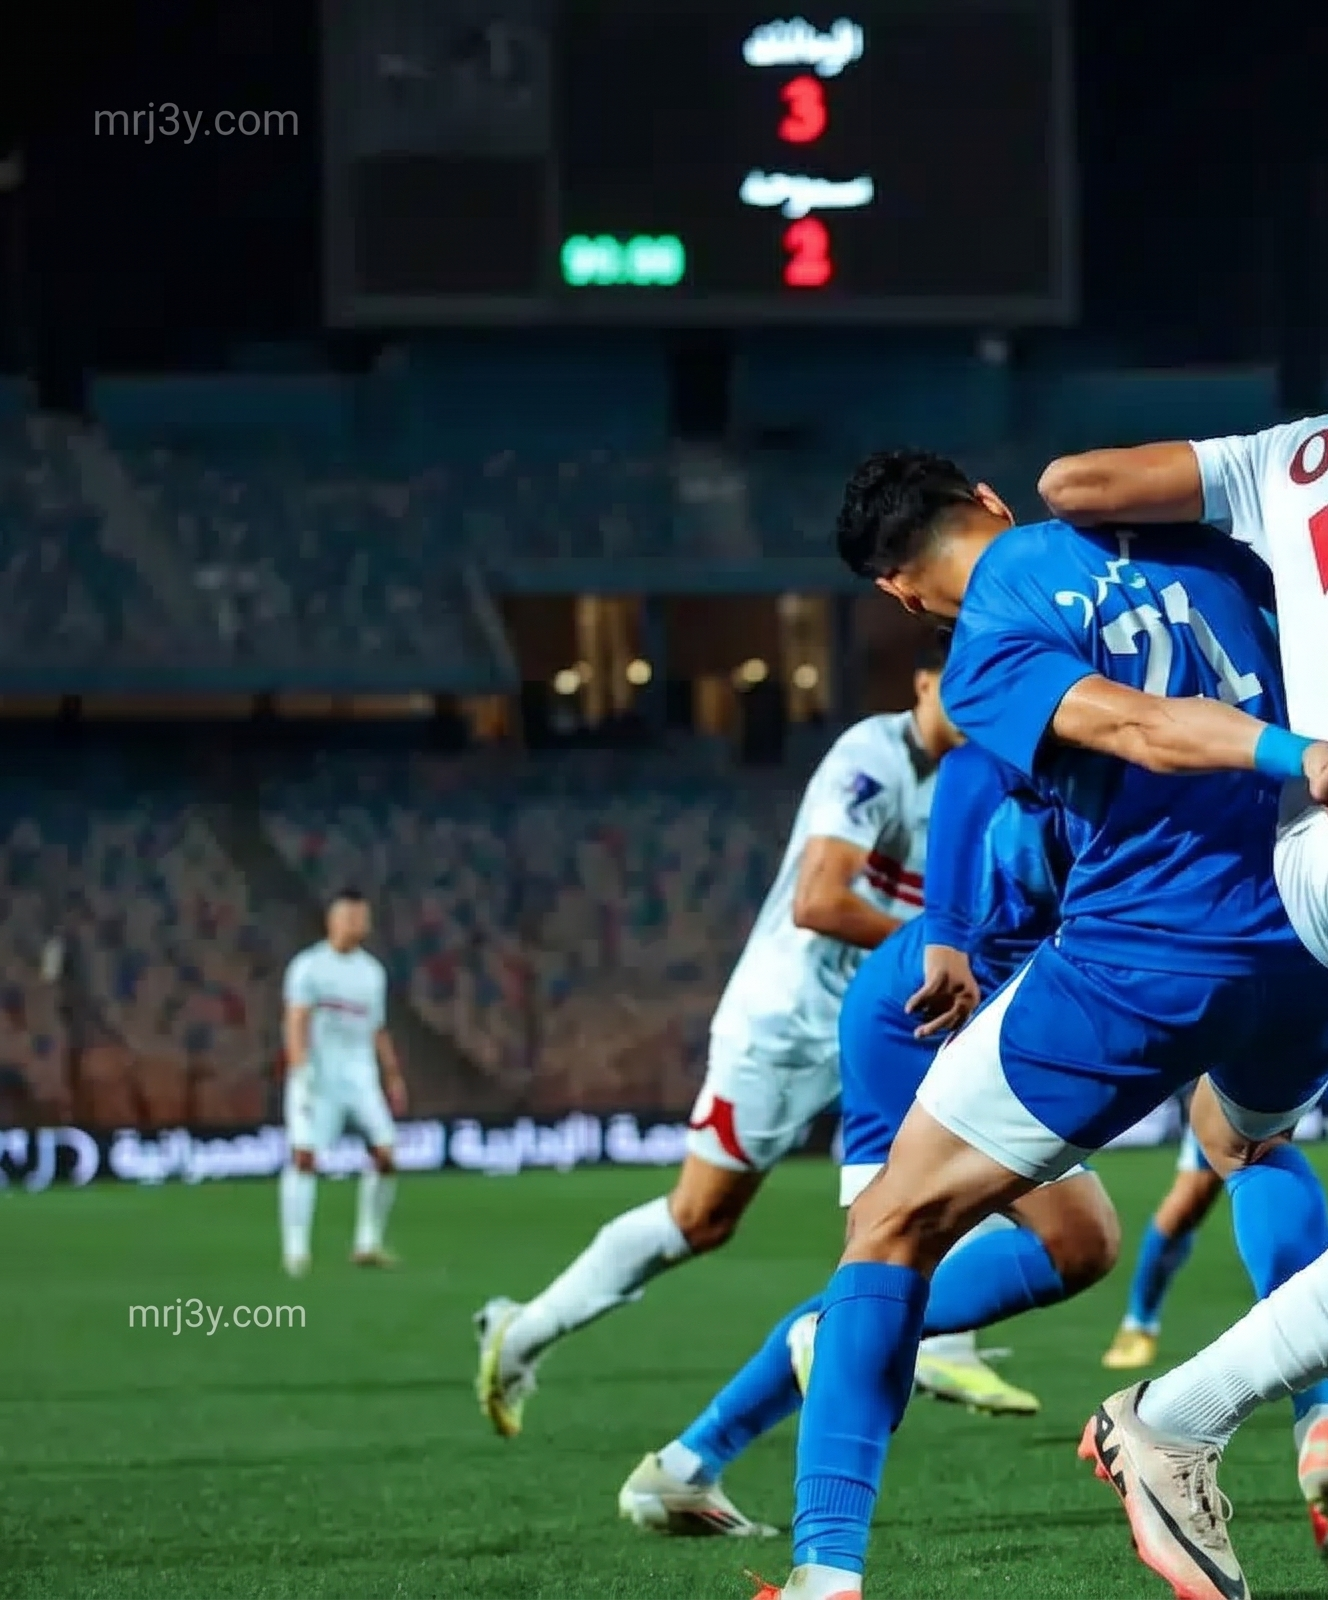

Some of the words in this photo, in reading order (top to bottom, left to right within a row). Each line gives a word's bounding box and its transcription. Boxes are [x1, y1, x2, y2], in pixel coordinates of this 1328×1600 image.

[777, 74, 829, 143] 3
[781, 216, 833, 287] 2
[1100, 580, 1263, 705] 21
